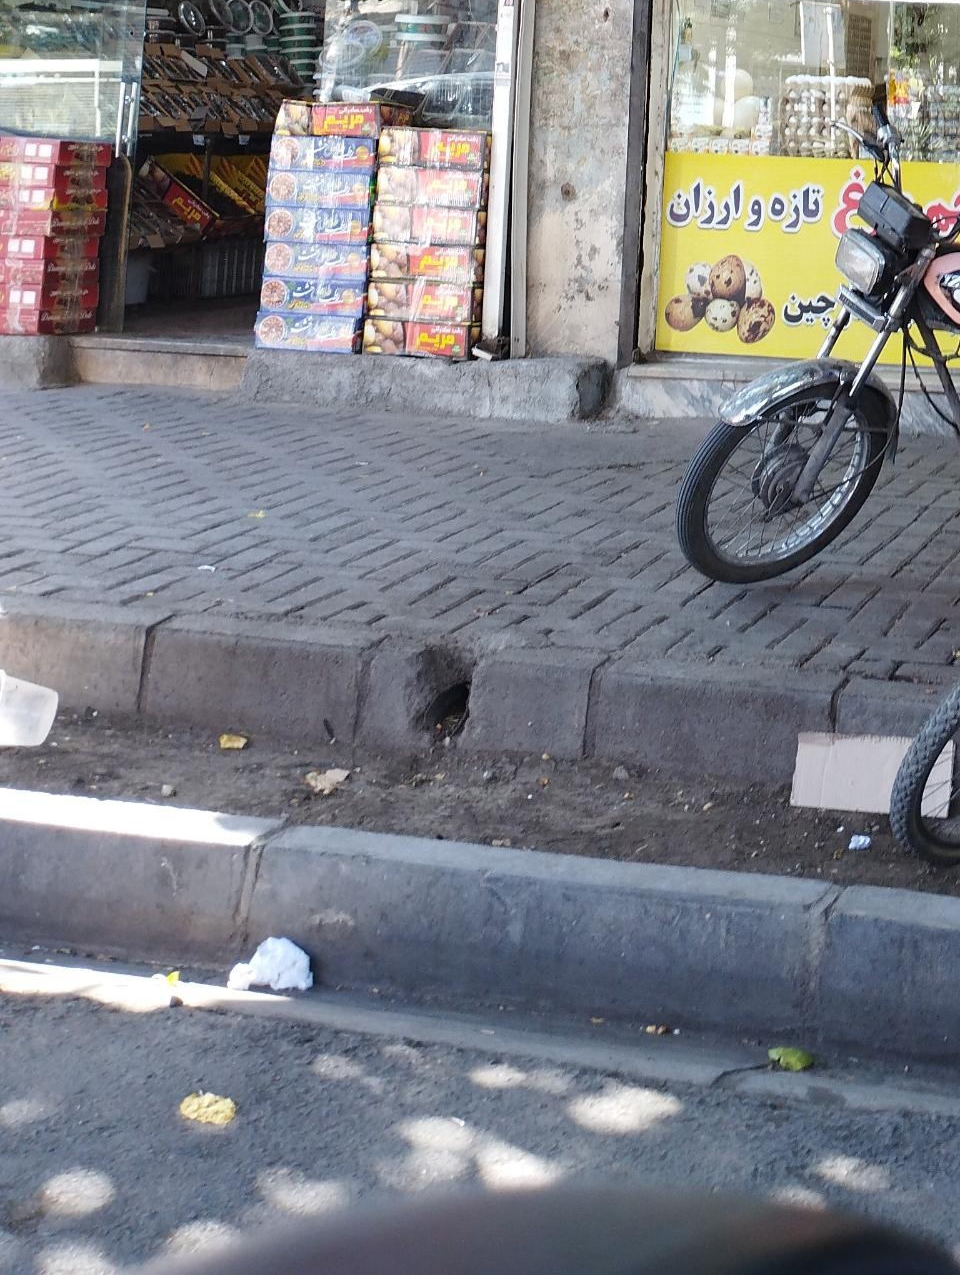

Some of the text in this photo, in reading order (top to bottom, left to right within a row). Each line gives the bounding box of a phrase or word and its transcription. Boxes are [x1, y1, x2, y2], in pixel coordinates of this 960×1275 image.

[323, 114, 364, 131] مریم
[669, 181, 742, 226] ارزان
[747, 198, 763, 227] و
[770, 186, 821, 229] تازه
[416, 332, 456, 350] مریم
